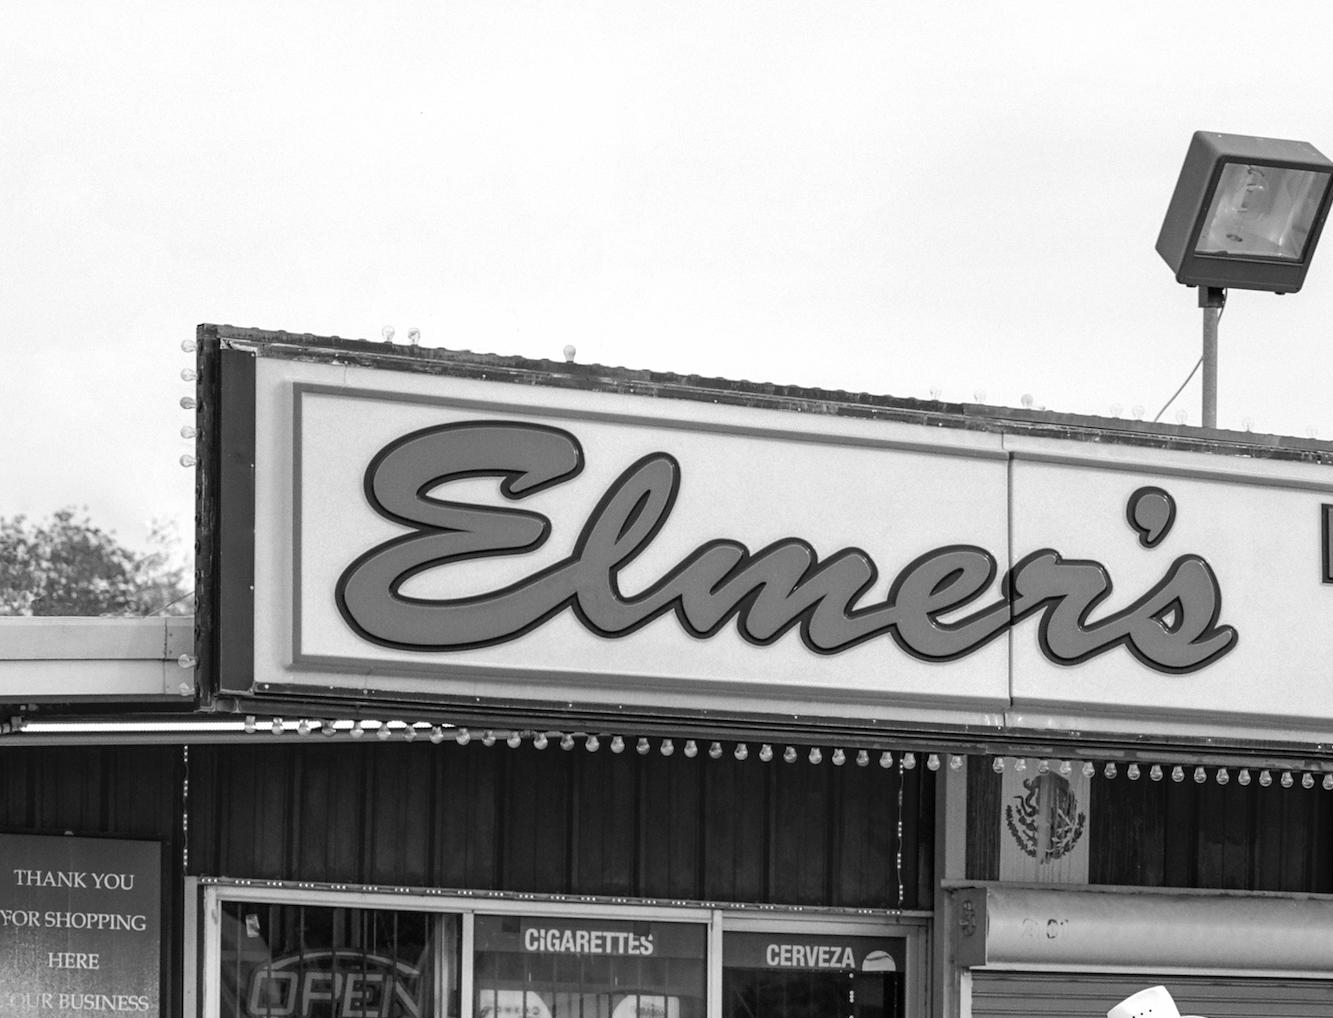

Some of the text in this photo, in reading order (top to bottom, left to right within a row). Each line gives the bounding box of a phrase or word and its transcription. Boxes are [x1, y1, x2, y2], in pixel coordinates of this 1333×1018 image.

[336, 420, 1238, 675] Elmer's
[13, 869, 135, 891] THANK YOU
[45, 910, 147, 931] SHOPPING
[525, 928, 654, 956] CIGARETTES
[48, 952, 100, 970] HERE
[766, 944, 856, 969] CERVEZA
[8, 992, 150, 1012] OUR BUSINESS
[249, 970, 424, 1018] OPEN
